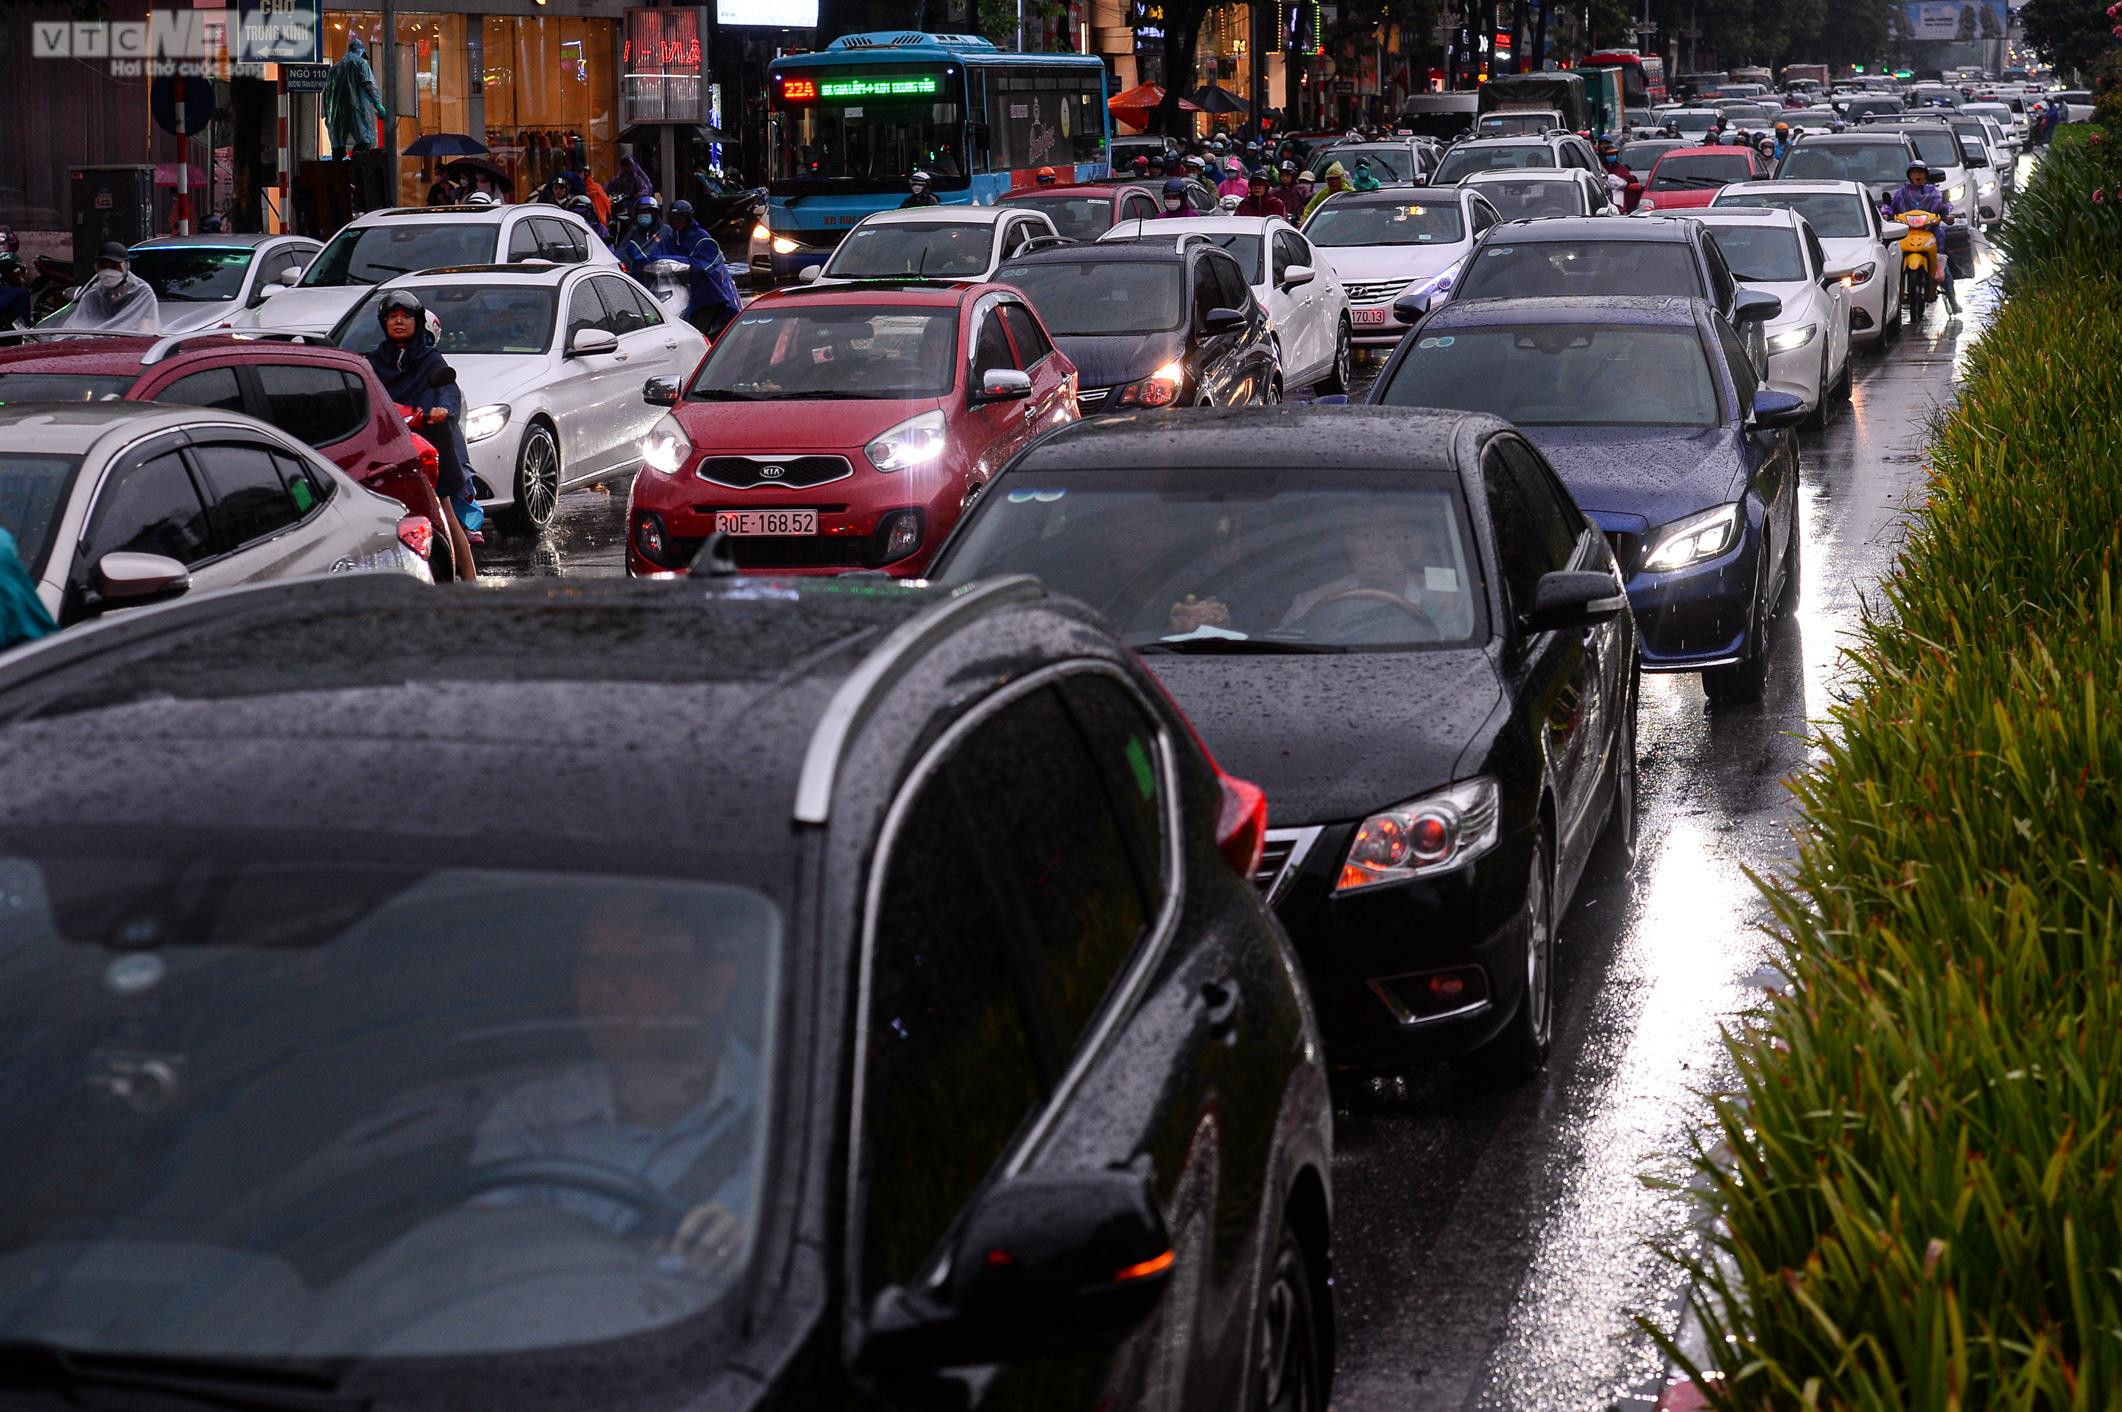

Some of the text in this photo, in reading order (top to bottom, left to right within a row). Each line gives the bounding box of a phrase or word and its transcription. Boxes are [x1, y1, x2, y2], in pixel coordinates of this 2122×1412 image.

[261, 0, 295, 18] CHỢ
[245, 21, 309, 41] TRUNG KÍNH
[313, 70, 327, 78] 110
[785, 82, 815, 97] 22A
[763, 468, 780, 476] KIA
[718, 514, 814, 533] 30E-168.52
